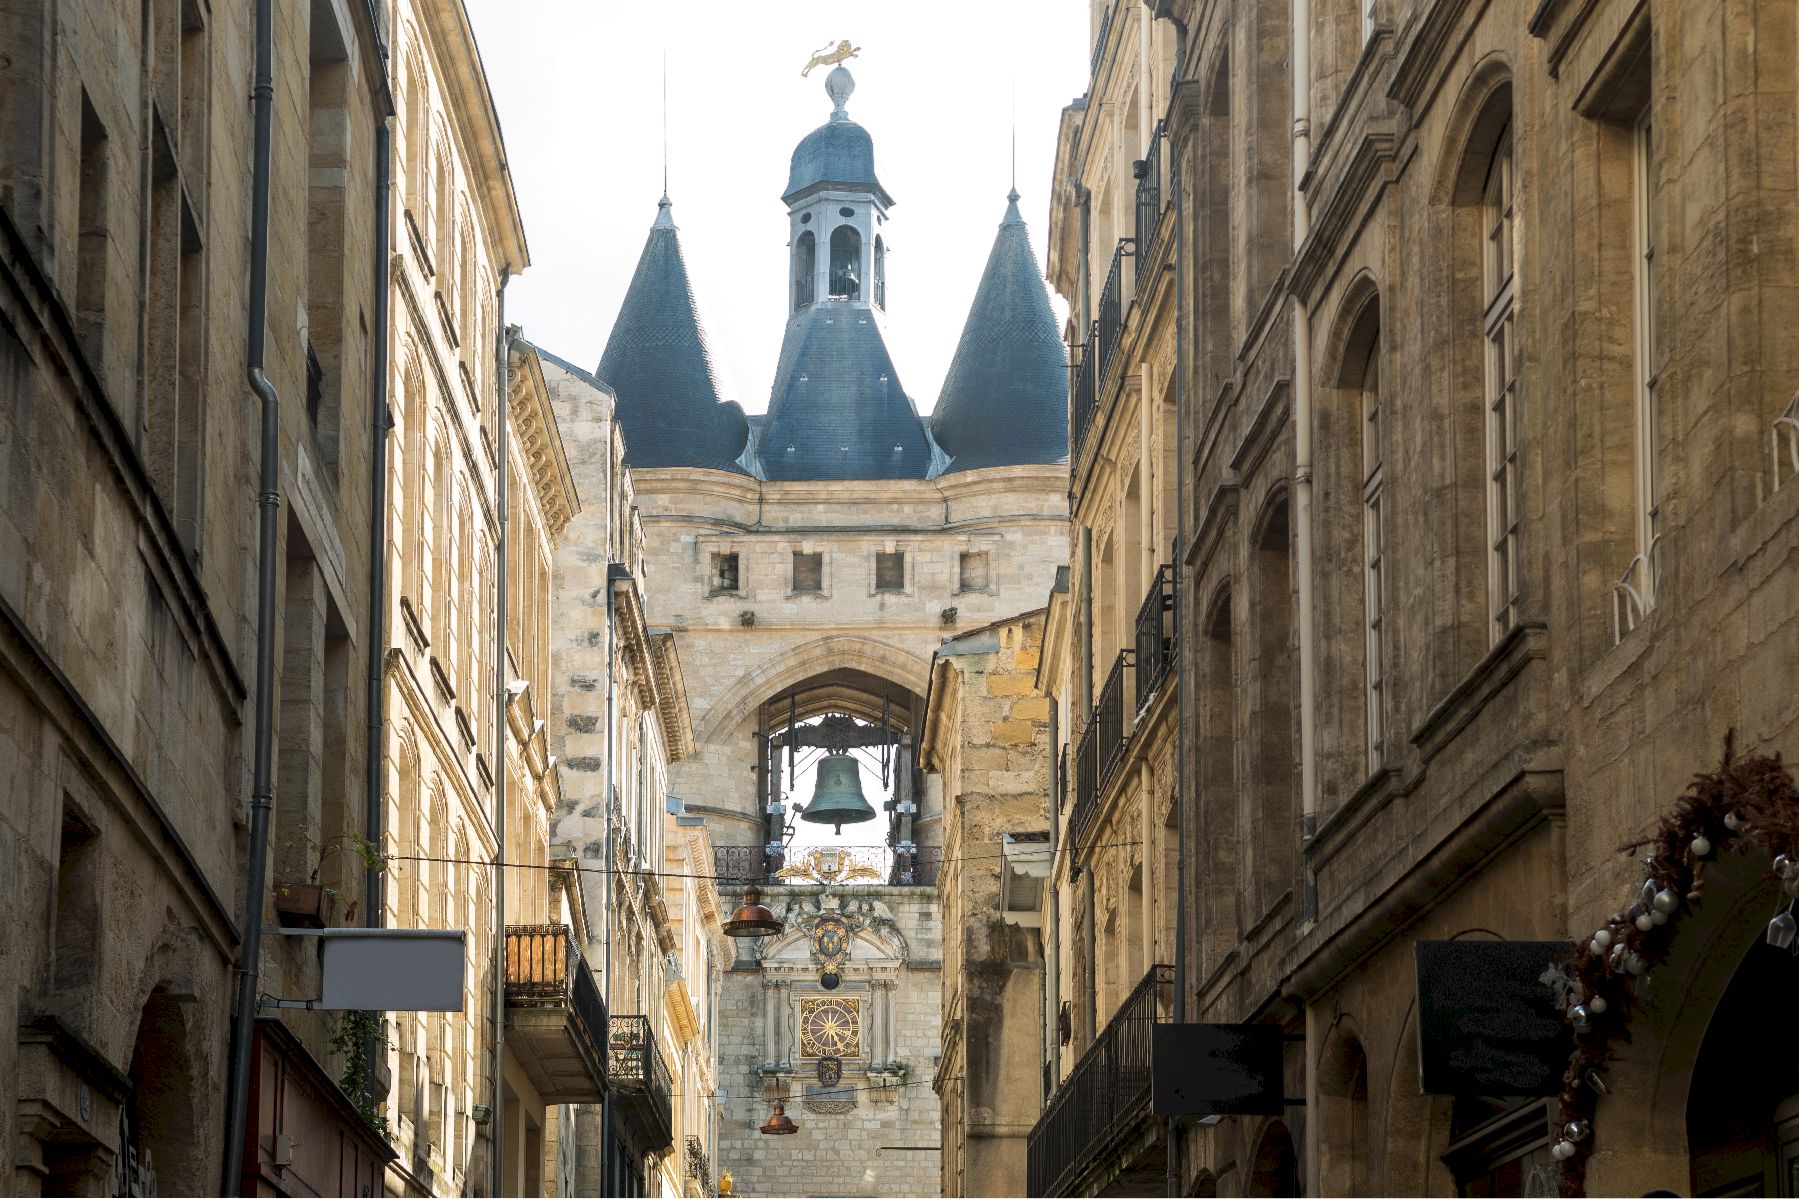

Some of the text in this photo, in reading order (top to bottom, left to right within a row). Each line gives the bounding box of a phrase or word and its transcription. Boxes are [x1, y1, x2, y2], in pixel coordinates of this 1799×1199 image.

[810, 1001, 822, 1011] XI
[803, 1010, 812, 1019] X
[801, 1023, 809, 1033] IX
